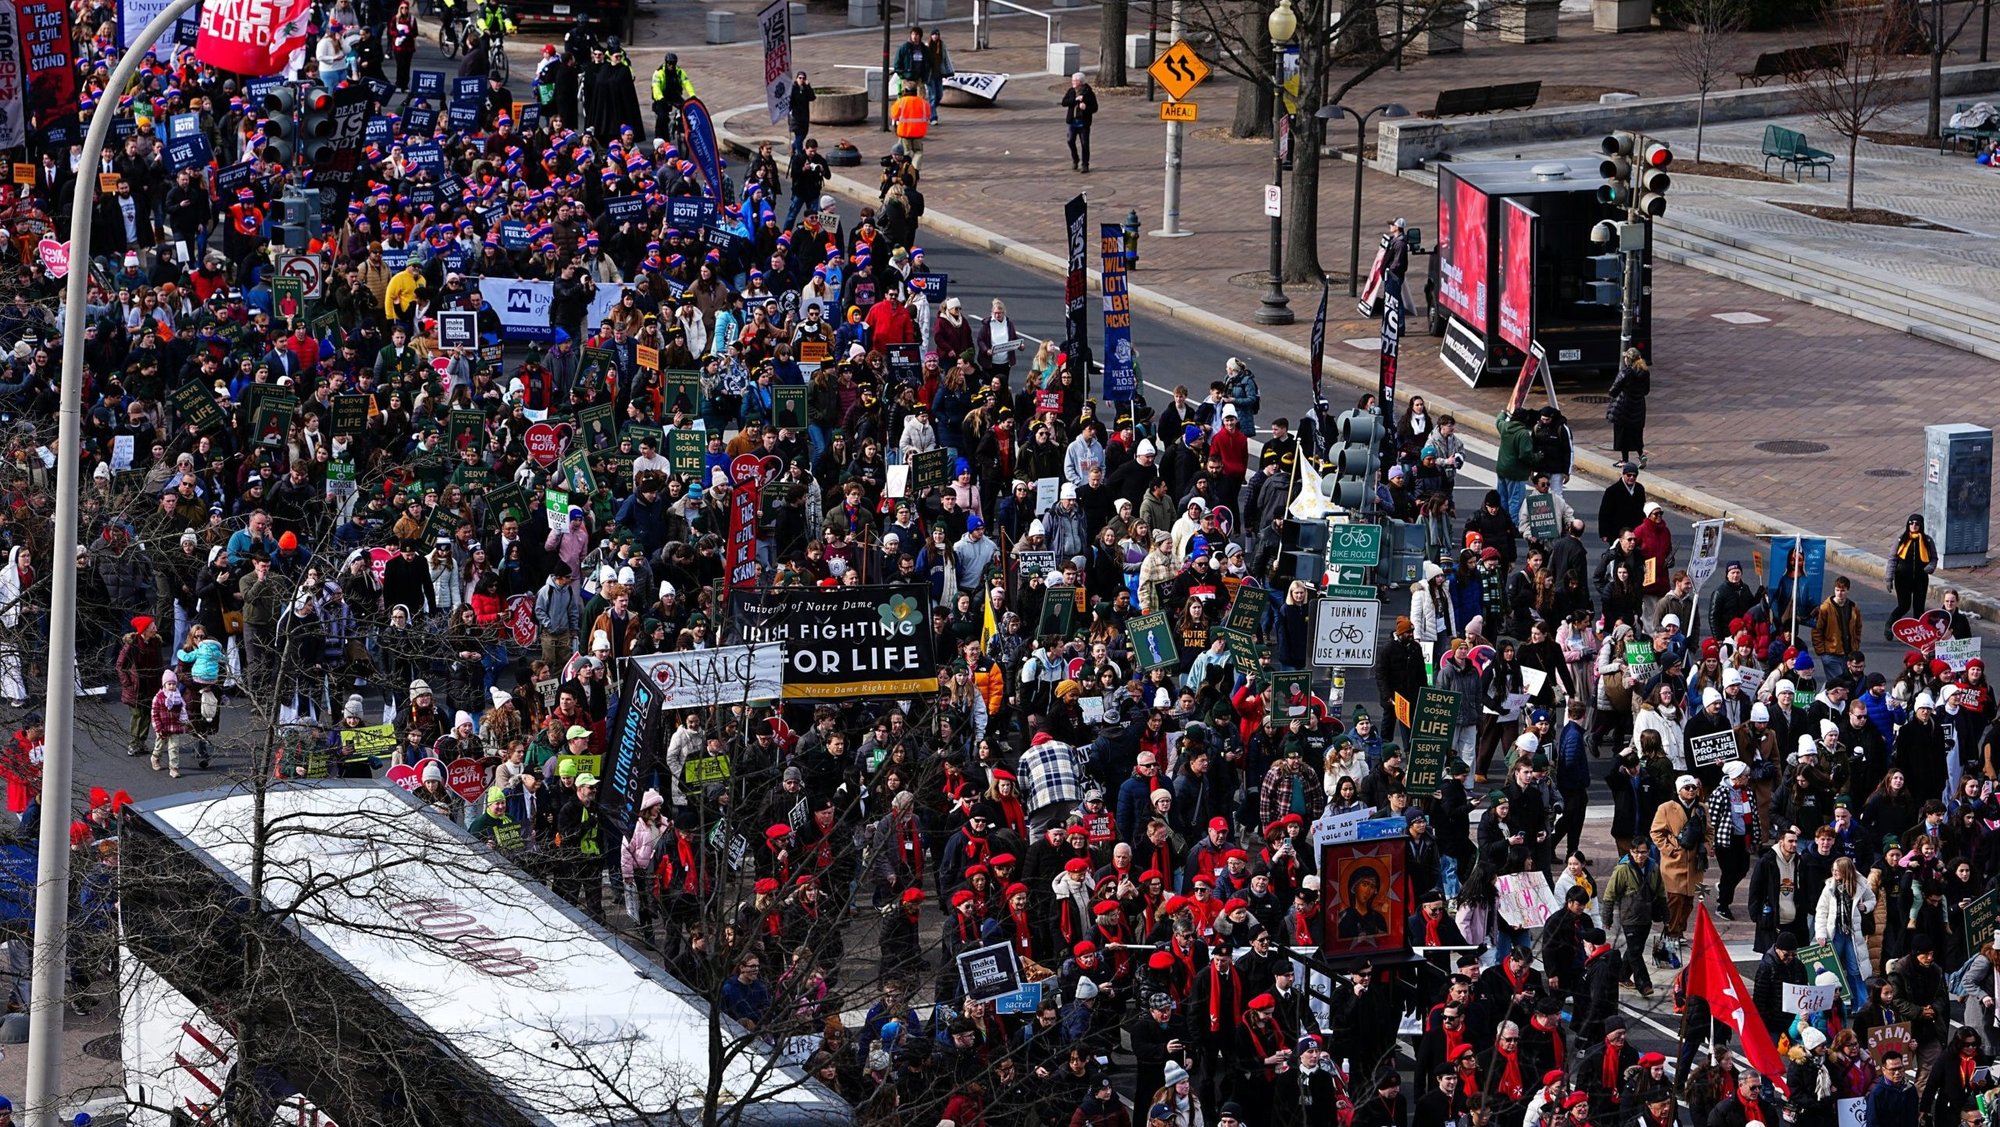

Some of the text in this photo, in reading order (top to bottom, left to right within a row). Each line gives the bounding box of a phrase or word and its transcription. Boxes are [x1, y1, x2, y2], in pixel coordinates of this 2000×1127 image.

[23, 5, 47, 14] IN THE
[34, 11, 62, 27] FACE
[139, 13, 149, 24] of
[207, 11, 271, 46] LORD
[26, 28, 62, 42] OF EVIL,
[31, 43, 50, 56] WE
[31, 54, 66, 71] STAND
[419, 78, 437, 88] LIFE
[461, 84, 479, 93] LIFE
[251, 88, 266, 96] FOR
[335, 99, 368, 117] DEATH
[1164, 108, 1193, 117] AHEAD
[410, 116, 429, 126] LIFE
[450, 111, 476, 121] FEEL JOY
[523, 111, 538, 120] BOTH
[174, 122, 195, 132] BOTH
[330, 112, 364, 141] IS
[169, 143, 190, 154] CHOOSE
[326, 135, 361, 151] NOT
[172, 150, 194, 162] LIFE
[408, 154, 440, 163] FOR LIFE
[218, 170, 248, 184] FEEL JOY
[441, 183, 461, 197] LIFE
[609, 203, 643, 214] FEEL JOY
[673, 206, 698, 217] BOTH
[819, 213, 838, 223] LIFE
[504, 230, 519, 238] FEEL
[710, 230, 731, 240] CHOOSE
[708, 234, 730, 248] LIFE
[1102, 237, 1118, 253] GOD
[42, 246, 63, 257] LOVE
[44, 253, 67, 264] BOTH
[395, 259, 410, 267] JOY
[447, 261, 462, 269] JOY
[1112, 295, 1129, 312] BE
[535, 305, 545, 316] of
[445, 331, 470, 339] babies.
[506, 326, 541, 335] BISMARCK,
[339, 397, 364, 405] SERVE
[190, 404, 216, 424] LIFE
[336, 417, 362, 428] LIFE
[530, 433, 553, 443] LOVE
[675, 432, 700, 442] SERVE
[531, 442, 556, 451] BOTH
[328, 462, 355, 473] LOVE LIFE
[675, 457, 700, 469] LIFE
[735, 463, 759, 472] LOVE
[917, 469, 943, 483] LIFE
[328, 480, 354, 489] CHOOSE
[545, 489, 569, 504] LOVE LIFE
[1532, 500, 1547, 508] EVERY
[436, 510, 458, 526] SERVE
[548, 510, 567, 524] CHOOSE
[1530, 513, 1554, 521] DESERVES
[1535, 519, 1557, 528] DEFENSE
[1331, 550, 1377, 559] BIKE ROUTE
[1694, 568, 1711, 579] LIFE
[1242, 590, 1265, 600] SERVE
[1334, 587, 1369, 596] Nationals Park
[791, 600, 873, 613] of Notre Dame
[1238, 602, 1260, 612] GOSPEL
[517, 606, 535, 629] BOTH
[1331, 607, 1367, 618] TURNING
[1131, 615, 1163, 629] OUR LADY
[1137, 621, 1165, 632] SORROWS
[1232, 615, 1254, 630] LIFE
[514, 618, 531, 640] LOVE
[742, 621, 914, 643] IRISH FIGHTING
[1183, 629, 1207, 639] NOTRE
[1899, 624, 1925, 636] LOVE
[1907, 630, 1934, 643] BOTH
[1184, 638, 1206, 648] DAME
[1626, 642, 1652, 654] LOVE LIFE
[852, 645, 920, 671] LIFE
[1317, 648, 1372, 660] USE X-WALKS
[1235, 654, 1257, 671] LIFE
[677, 653, 756, 688] NALC
[1630, 664, 1656, 678] CHOOSE
[804, 682, 921, 694] Notre Dame Right Life
[1426, 692, 1455, 705] SERVE
[1794, 692, 1809, 703] LOVE
[1423, 706, 1452, 717] GOSPEL
[1419, 720, 1449, 736] LIFE
[635, 717, 648, 760] LIFE
[1716, 736, 1732, 745] THE
[612, 706, 640, 796] LUTHERANS
[1416, 743, 1441, 753] SERVE
[1694, 742, 1736, 755] PRO-LIFE
[1696, 749, 1737, 762] GENERATION
[577, 758, 594, 766] LCMS
[1414, 757, 1439, 766] GOSPEL
[450, 764, 475, 775] LOVE
[577, 764, 593, 772] LIFE
[704, 766, 721, 774] LIFE
[453, 773, 480, 785] BOTH
[1411, 771, 1436, 785] LIFE
[627, 765, 641, 803] FOR
[1098, 816, 1110, 824] FACE
[1340, 821, 1353, 829] ARE
[511, 830, 521, 839] life
[1321, 833, 1342, 842] VOICE
[1969, 898, 1992, 917] SERVE
[1971, 911, 1993, 929] GOSPEL
[1972, 925, 1995, 947] LIFE
[971, 958, 995, 970] make
[973, 966, 996, 978] more
[975, 975, 1008, 988] babies.
[1021, 985, 1036, 993] LIFE
[1791, 985, 1812, 997] Life
[1004, 1000, 1032, 1009] sacred
[1797, 994, 1824, 1010] Gift
[1868, 1025, 1912, 1049] STAND
